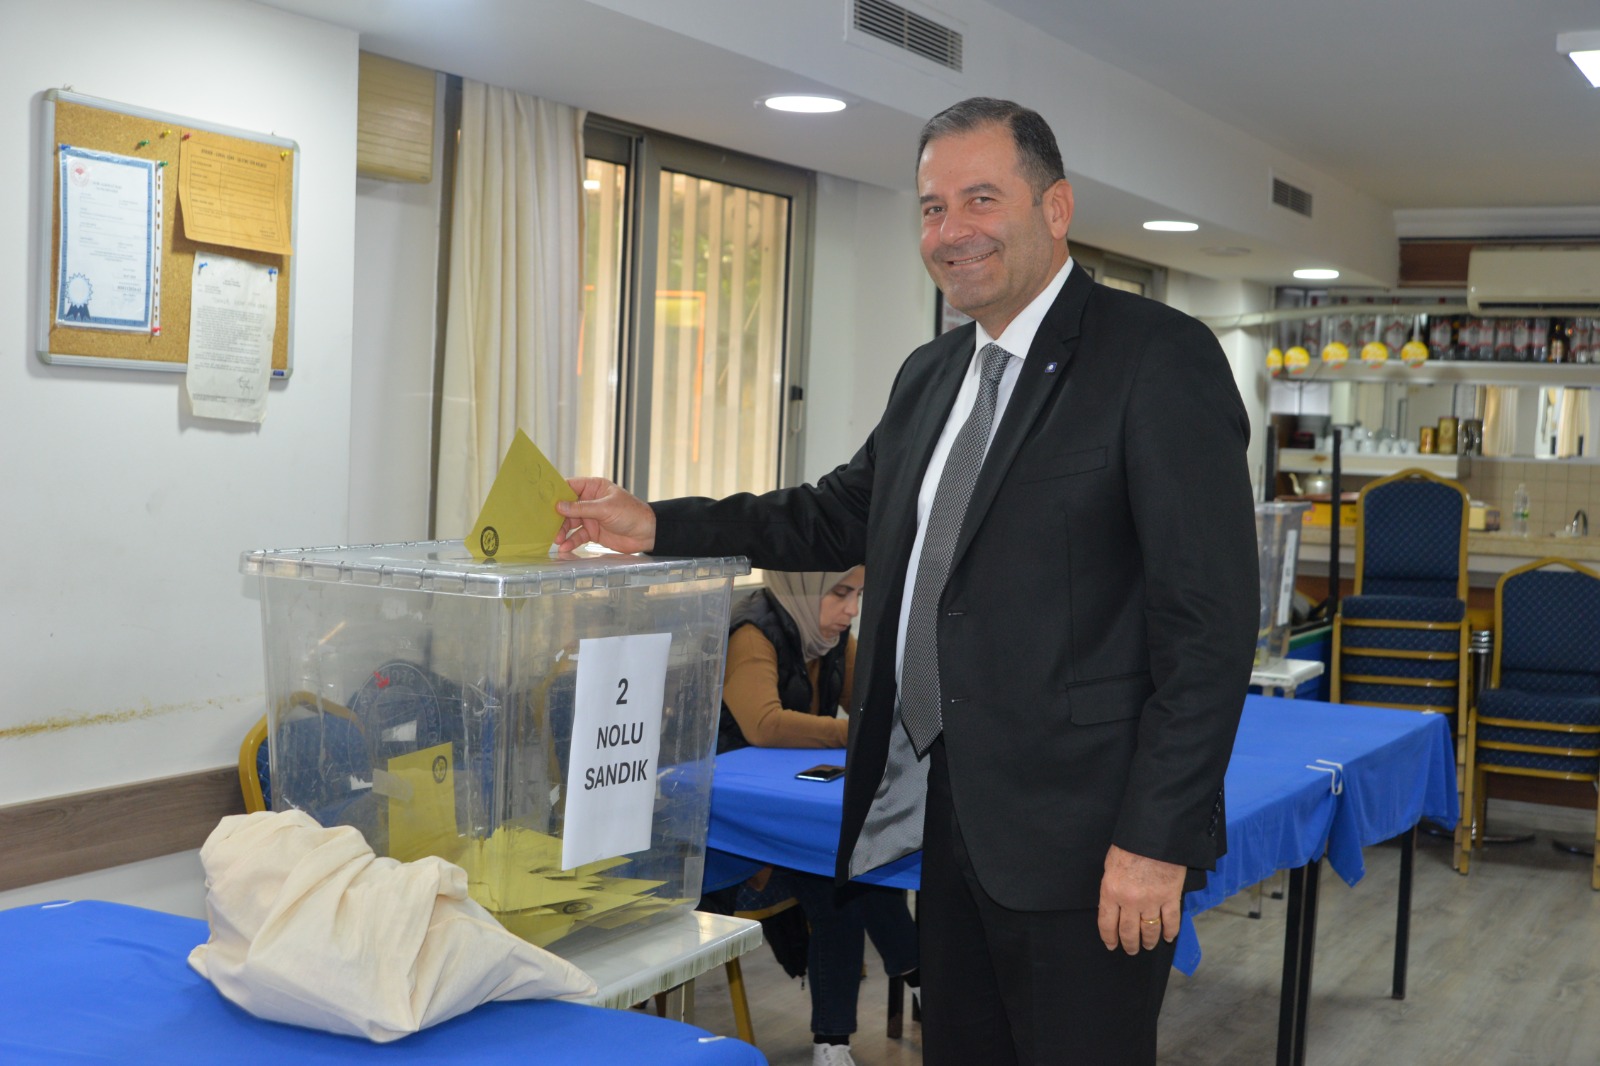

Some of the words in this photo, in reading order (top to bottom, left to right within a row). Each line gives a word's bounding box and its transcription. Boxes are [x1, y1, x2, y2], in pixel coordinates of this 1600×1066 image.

[616, 678, 629, 706] 2
[596, 721, 644, 750] NOLU
[584, 758, 649, 791] SANDIK
